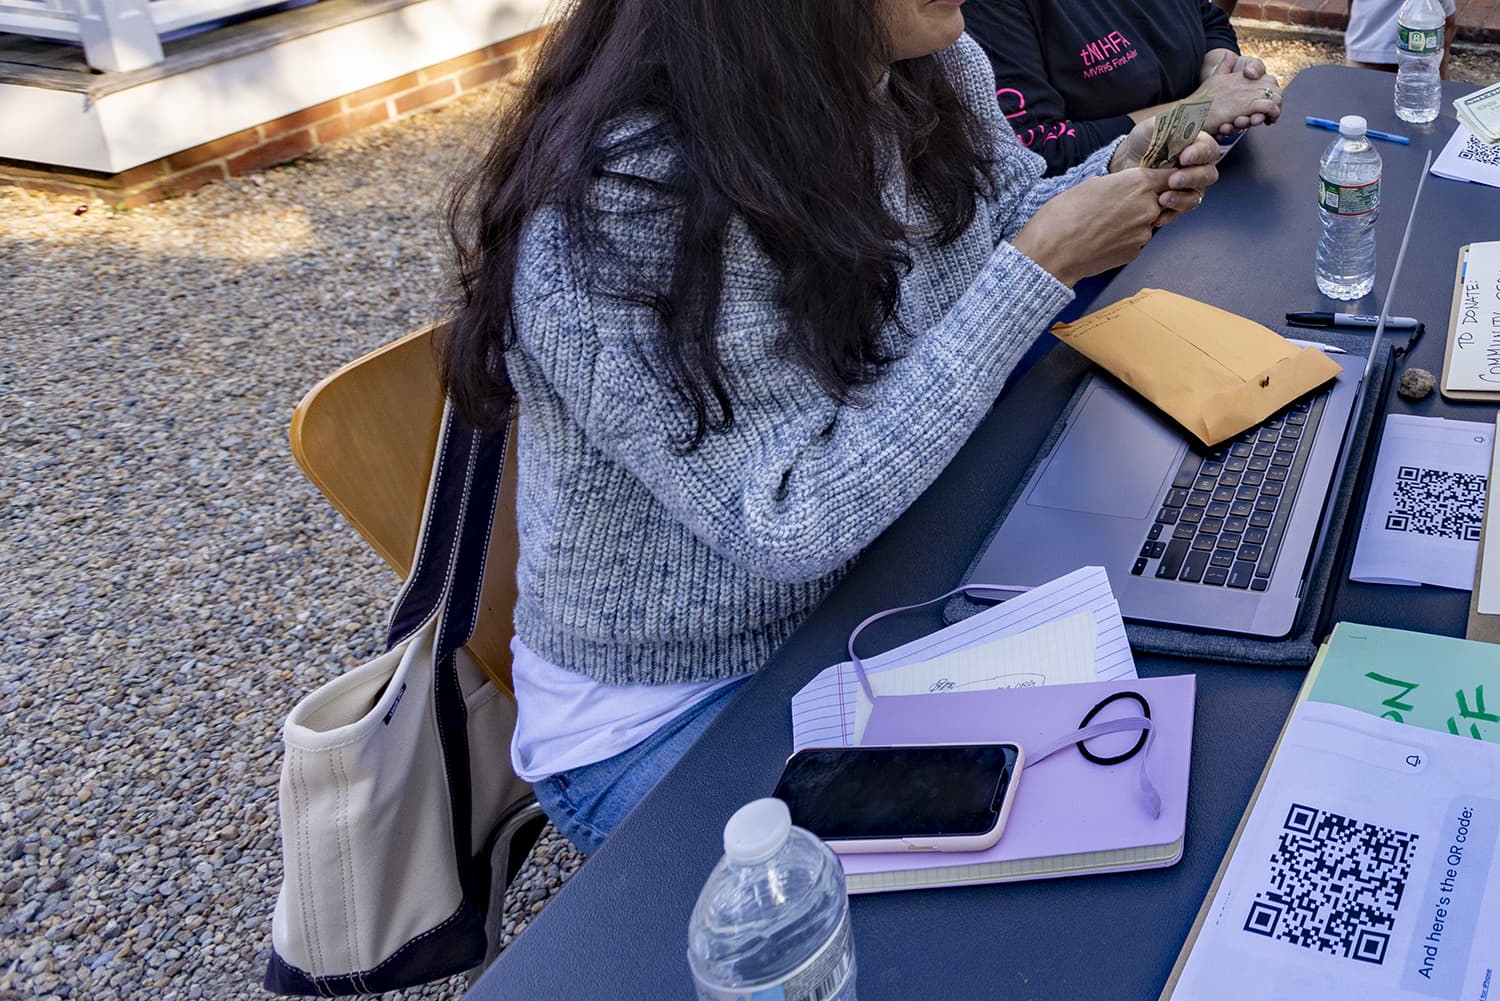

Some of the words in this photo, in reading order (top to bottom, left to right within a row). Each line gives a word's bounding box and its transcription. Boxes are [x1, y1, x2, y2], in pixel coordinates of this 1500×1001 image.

[1462, 280, 1481, 324] DONATE:
[1458, 332, 1475, 349] TO
[1456, 806, 1475, 844] code:
[1447, 846, 1463, 867] QR
[1440, 869, 1458, 892] the
[1425, 896, 1451, 942] here's
[1418, 945, 1438, 979] And
